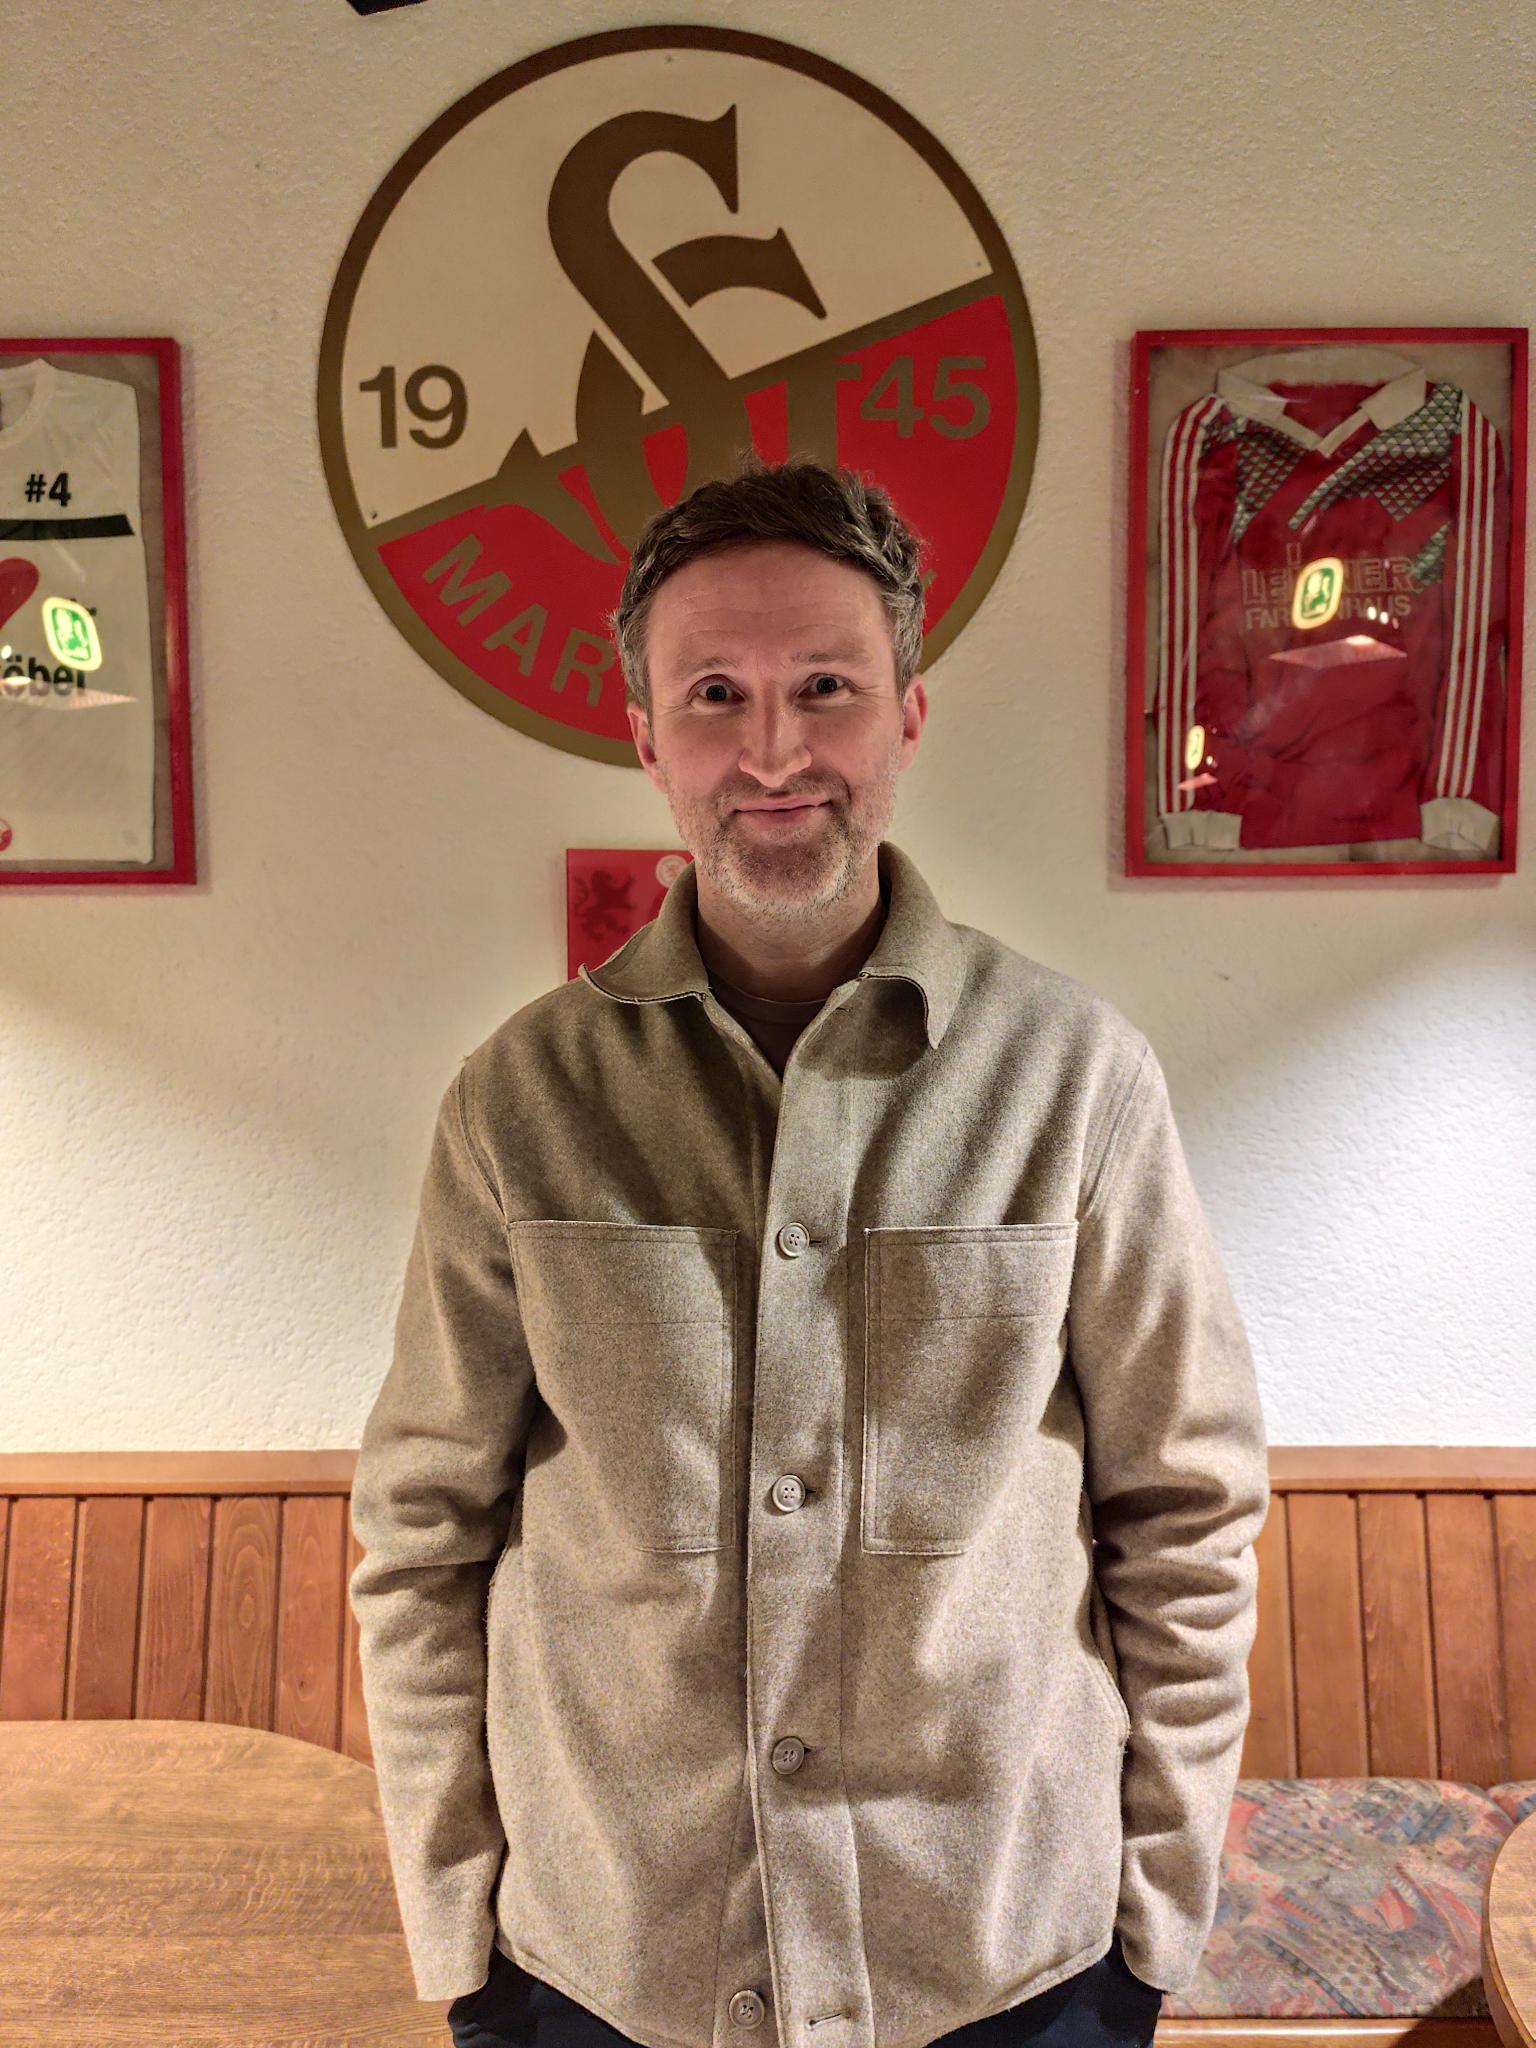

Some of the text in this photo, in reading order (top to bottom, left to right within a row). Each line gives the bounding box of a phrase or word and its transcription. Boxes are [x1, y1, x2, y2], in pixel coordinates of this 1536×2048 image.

[359, 364, 469, 450] 19
[860, 355, 992, 440] 45
[25, 472, 72, 507] #4
[422, 534, 616, 708] MAR
[1244, 594, 1412, 631] FARHAUS
[0, 654, 86, 696] öbel
